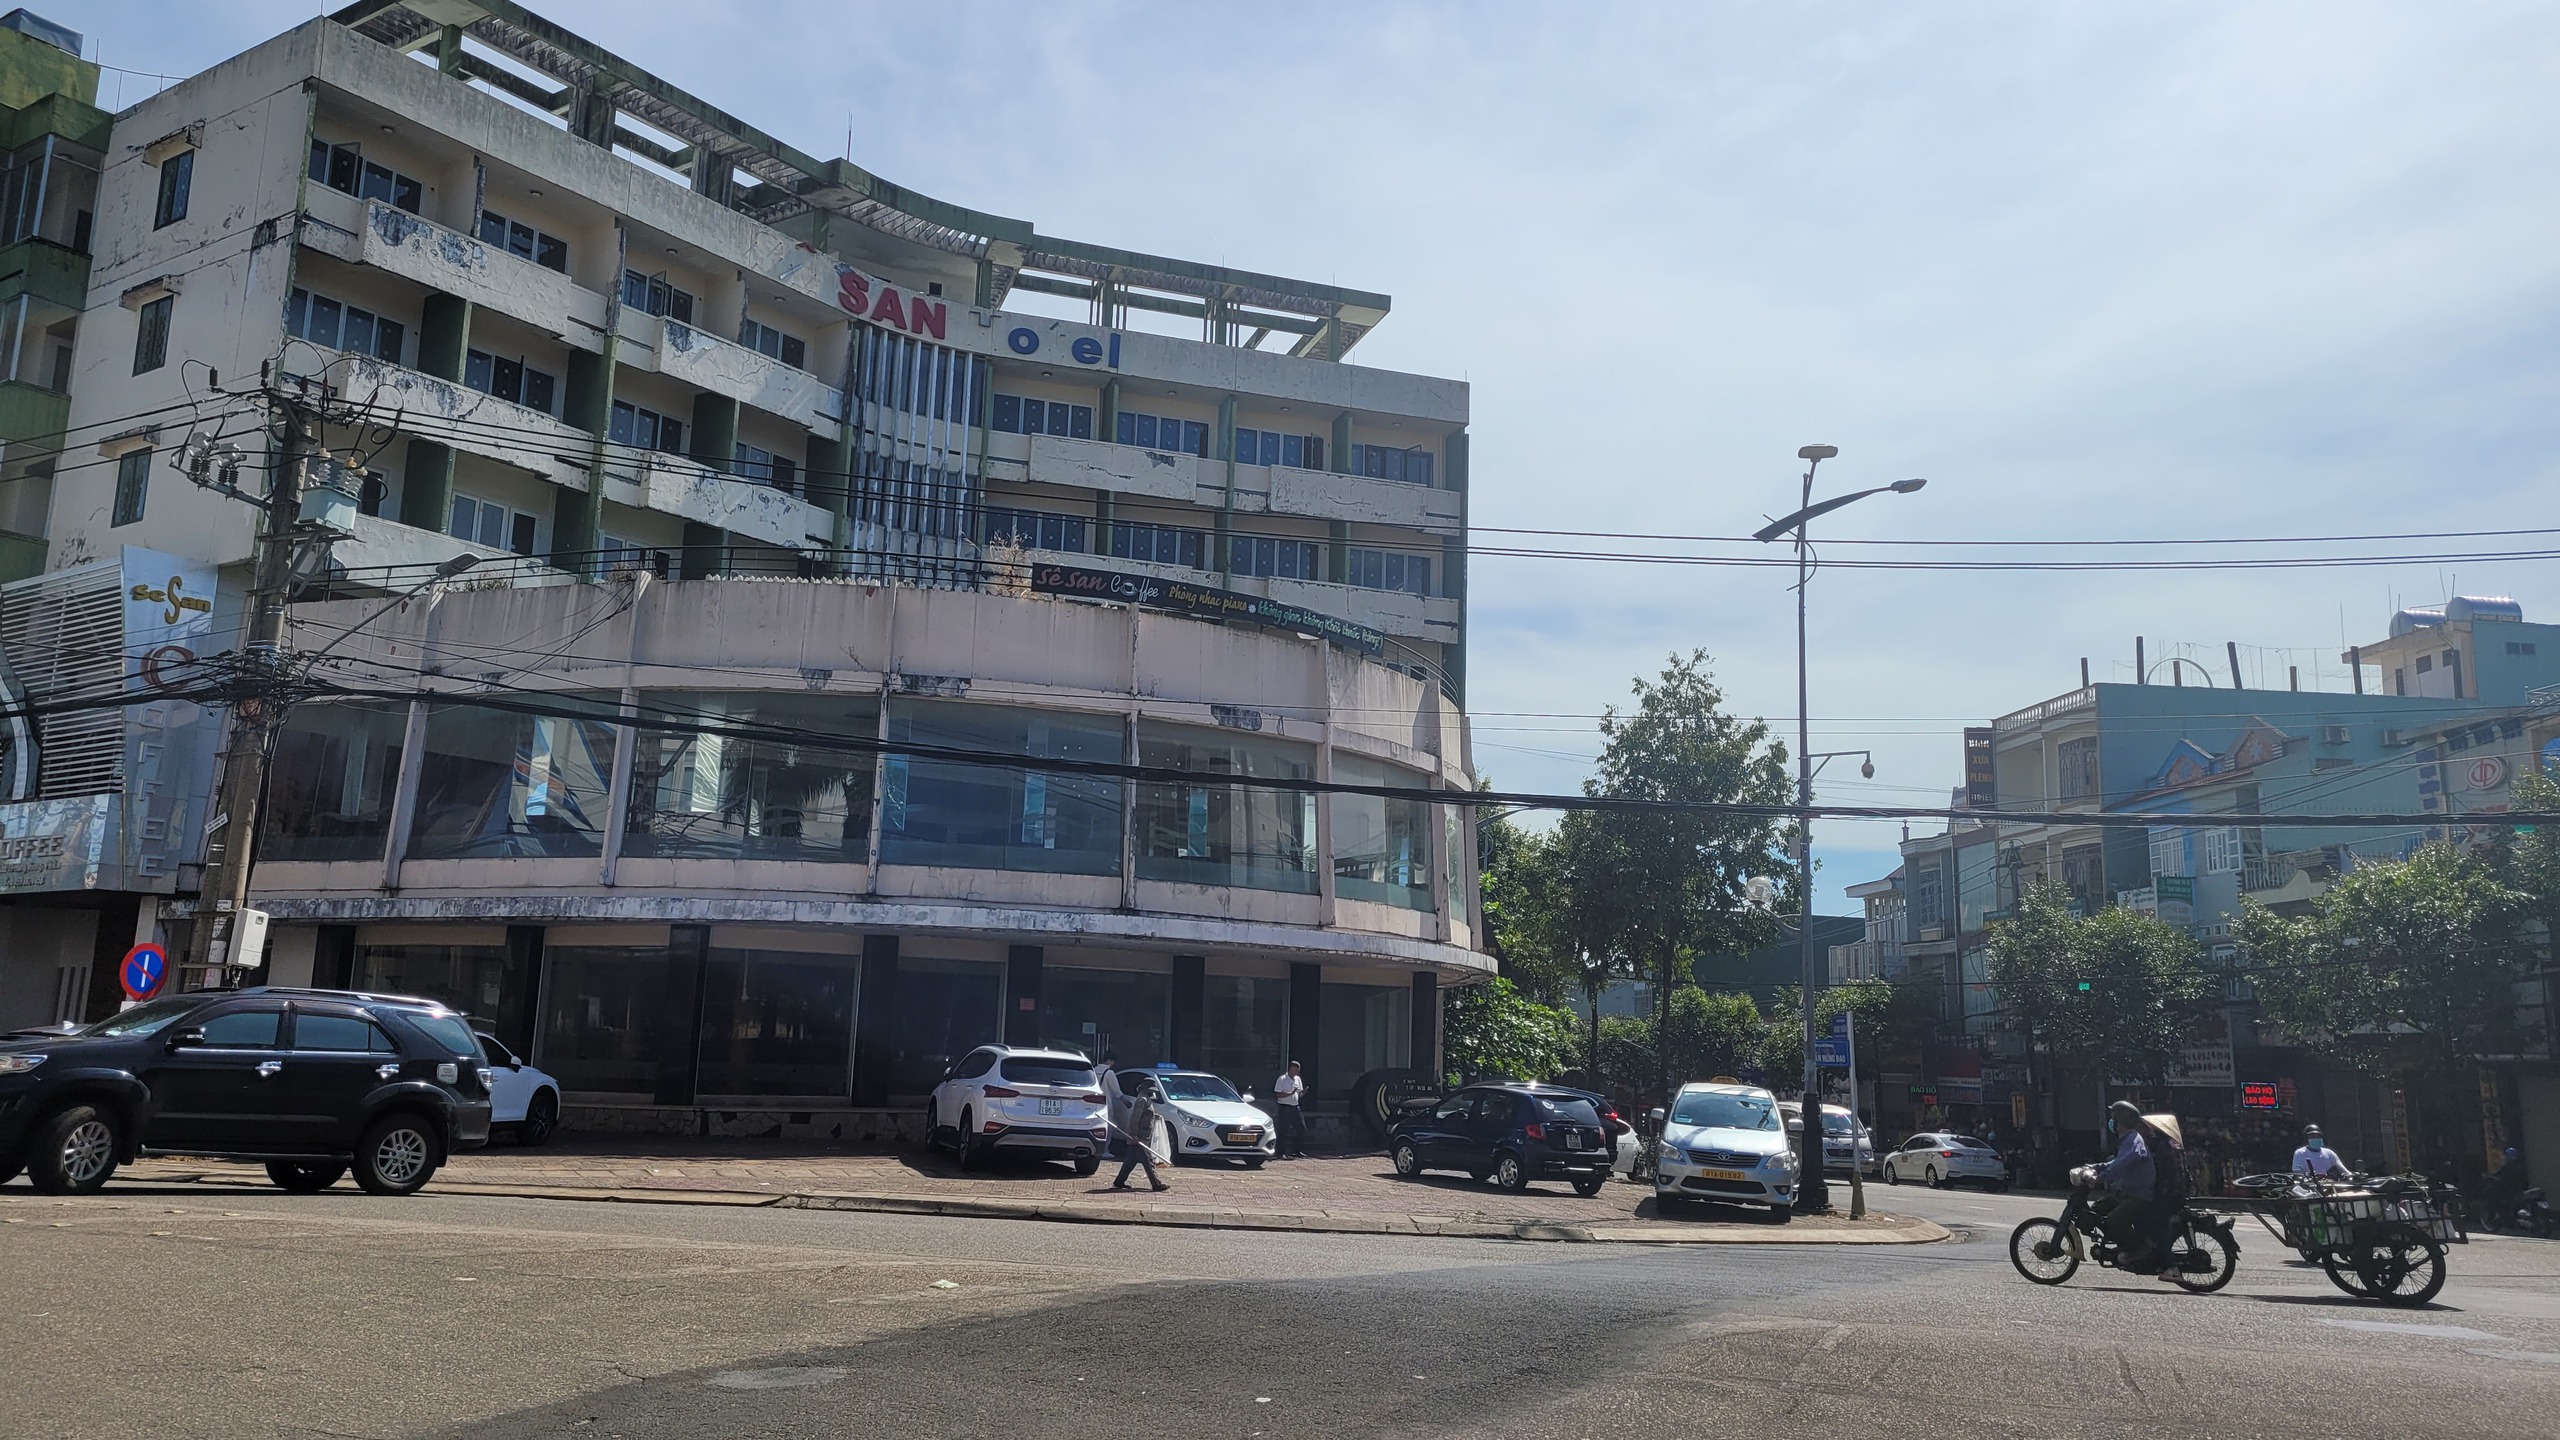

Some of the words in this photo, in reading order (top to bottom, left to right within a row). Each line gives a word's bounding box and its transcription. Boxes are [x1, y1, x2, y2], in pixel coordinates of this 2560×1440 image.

[838, 270, 946, 339] SAN
[1199, 590, 1222, 609] nhạc
[1222, 596, 1247, 613] piano
[0, 835, 65, 860] OFFEE
